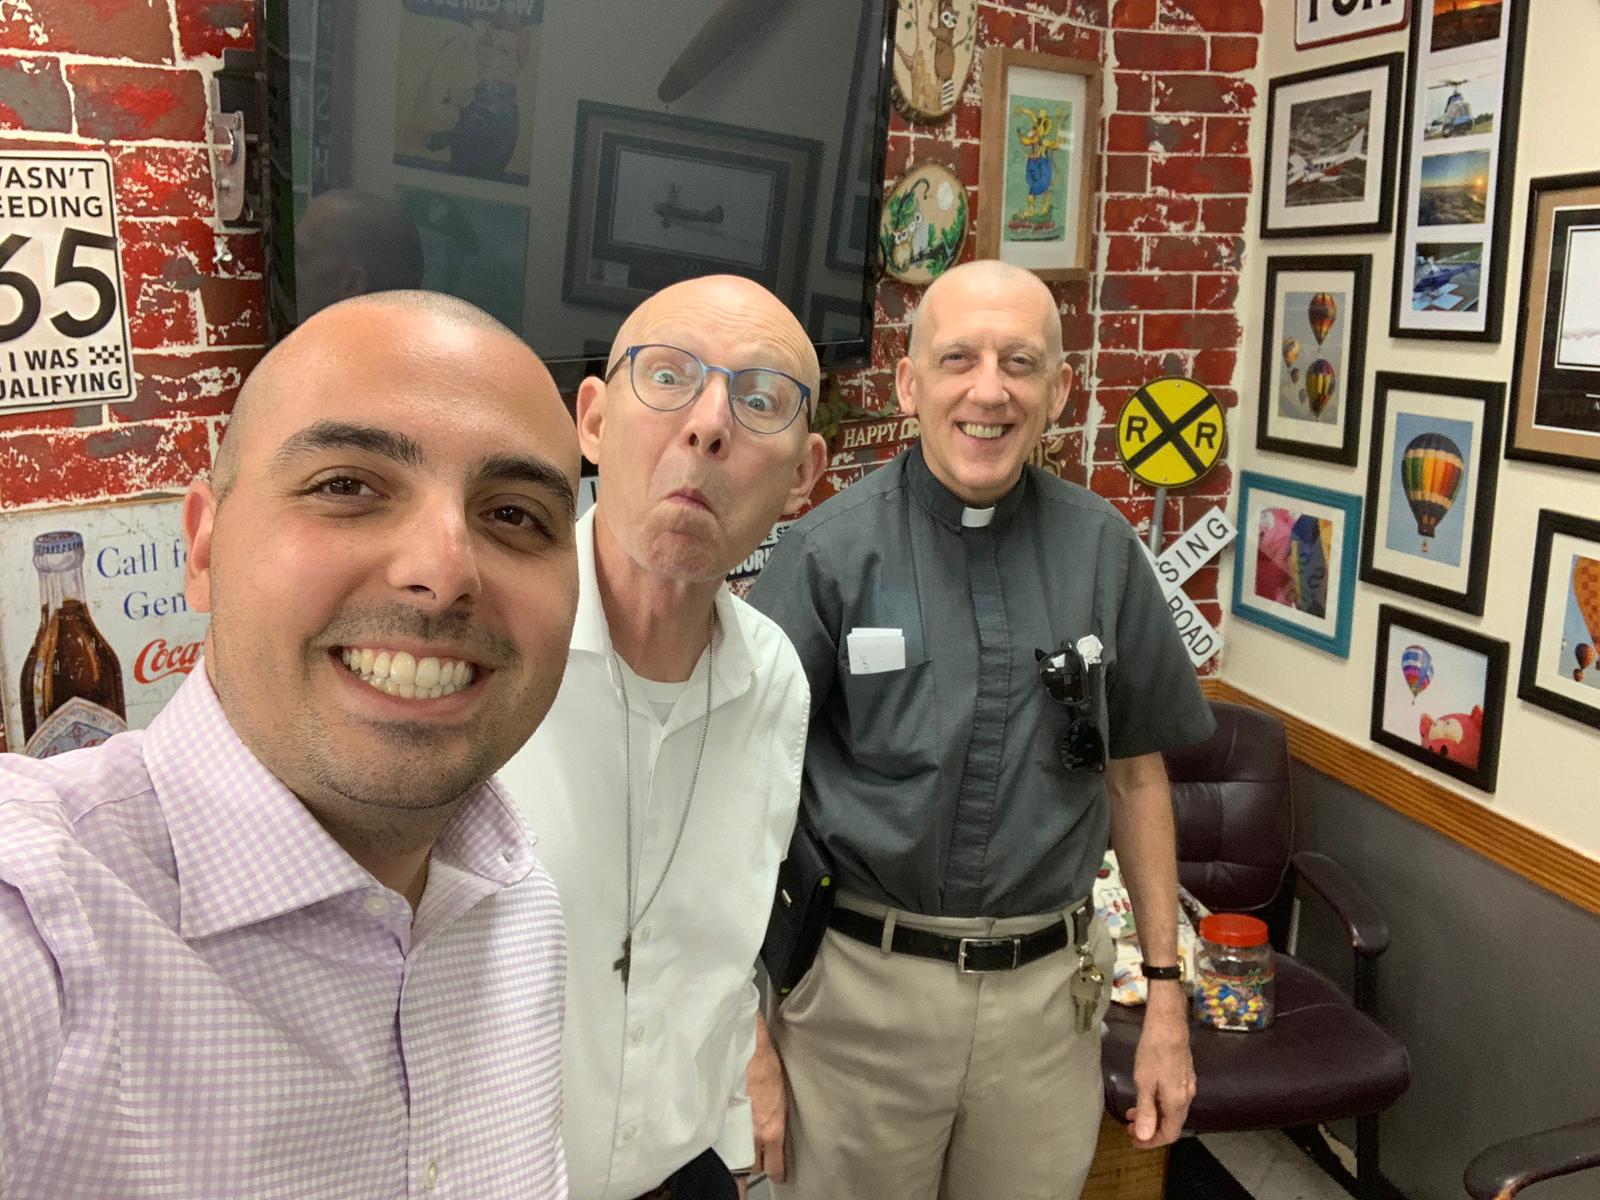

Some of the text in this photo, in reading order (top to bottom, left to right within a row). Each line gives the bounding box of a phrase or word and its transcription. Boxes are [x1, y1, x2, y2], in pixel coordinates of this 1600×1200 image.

[0, 166, 94, 189] ASN'T
[0, 196, 103, 218] EDING
[8, 347, 79, 373] I WAS
[843, 422, 899, 449] HAPPY
[1126, 415, 1218, 450] R R
[96, 538, 187, 579] Call f
[123, 590, 188, 621] Gen
